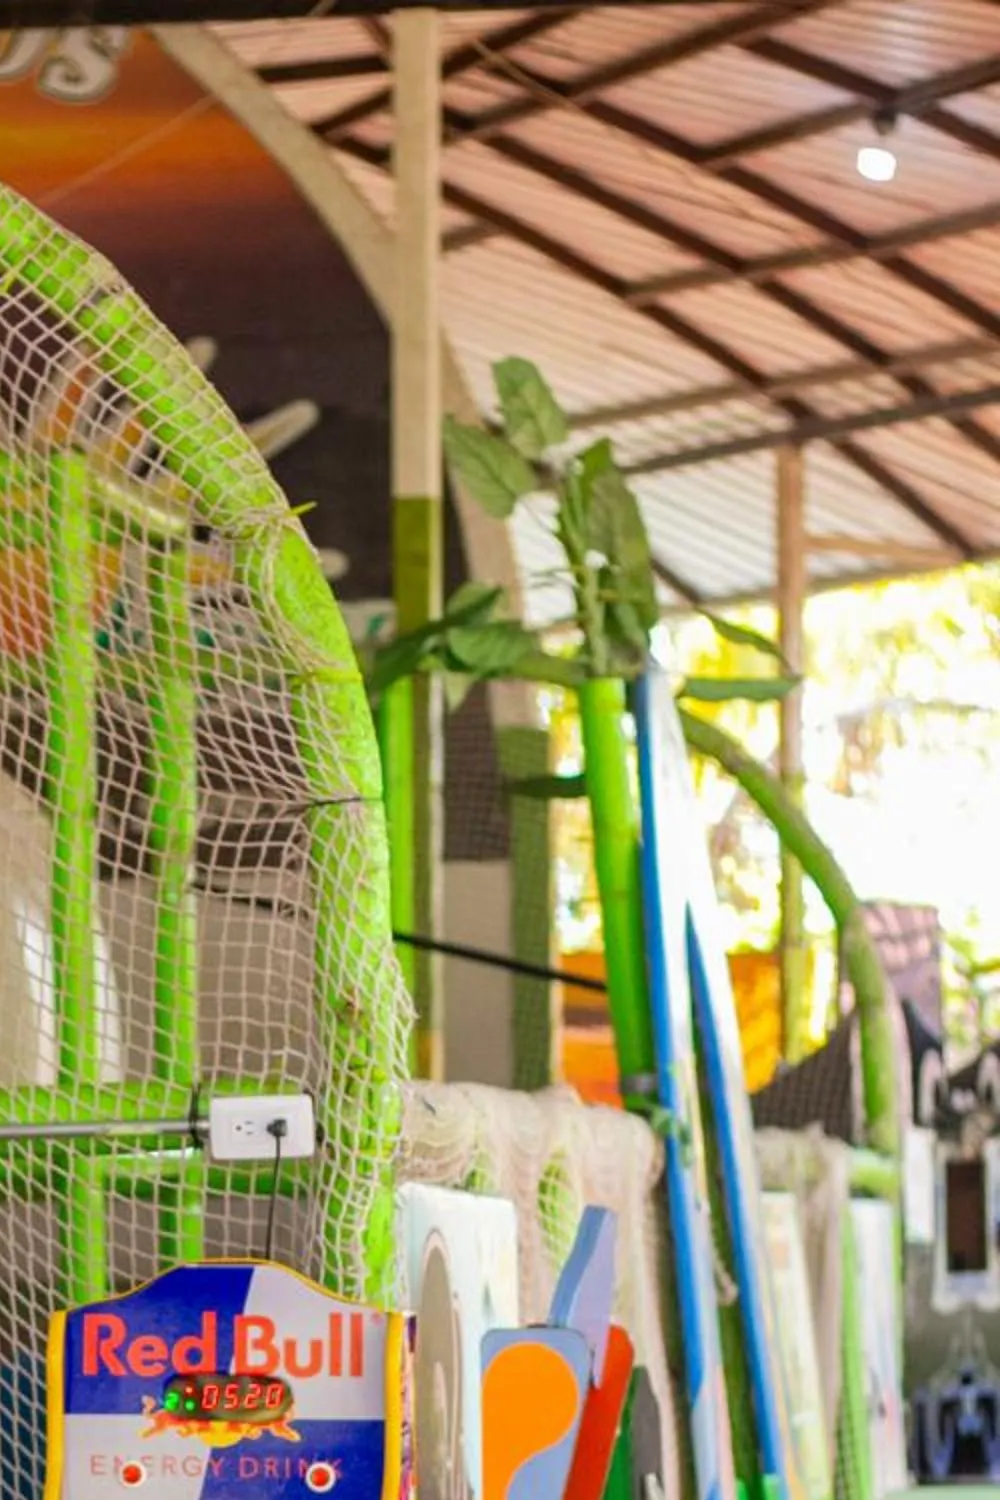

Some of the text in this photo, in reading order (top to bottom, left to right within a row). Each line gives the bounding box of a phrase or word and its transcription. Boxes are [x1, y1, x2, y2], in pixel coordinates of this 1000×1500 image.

[81, 1311, 364, 1378] Red Bull
[202, 1383, 284, 1409] 0520
